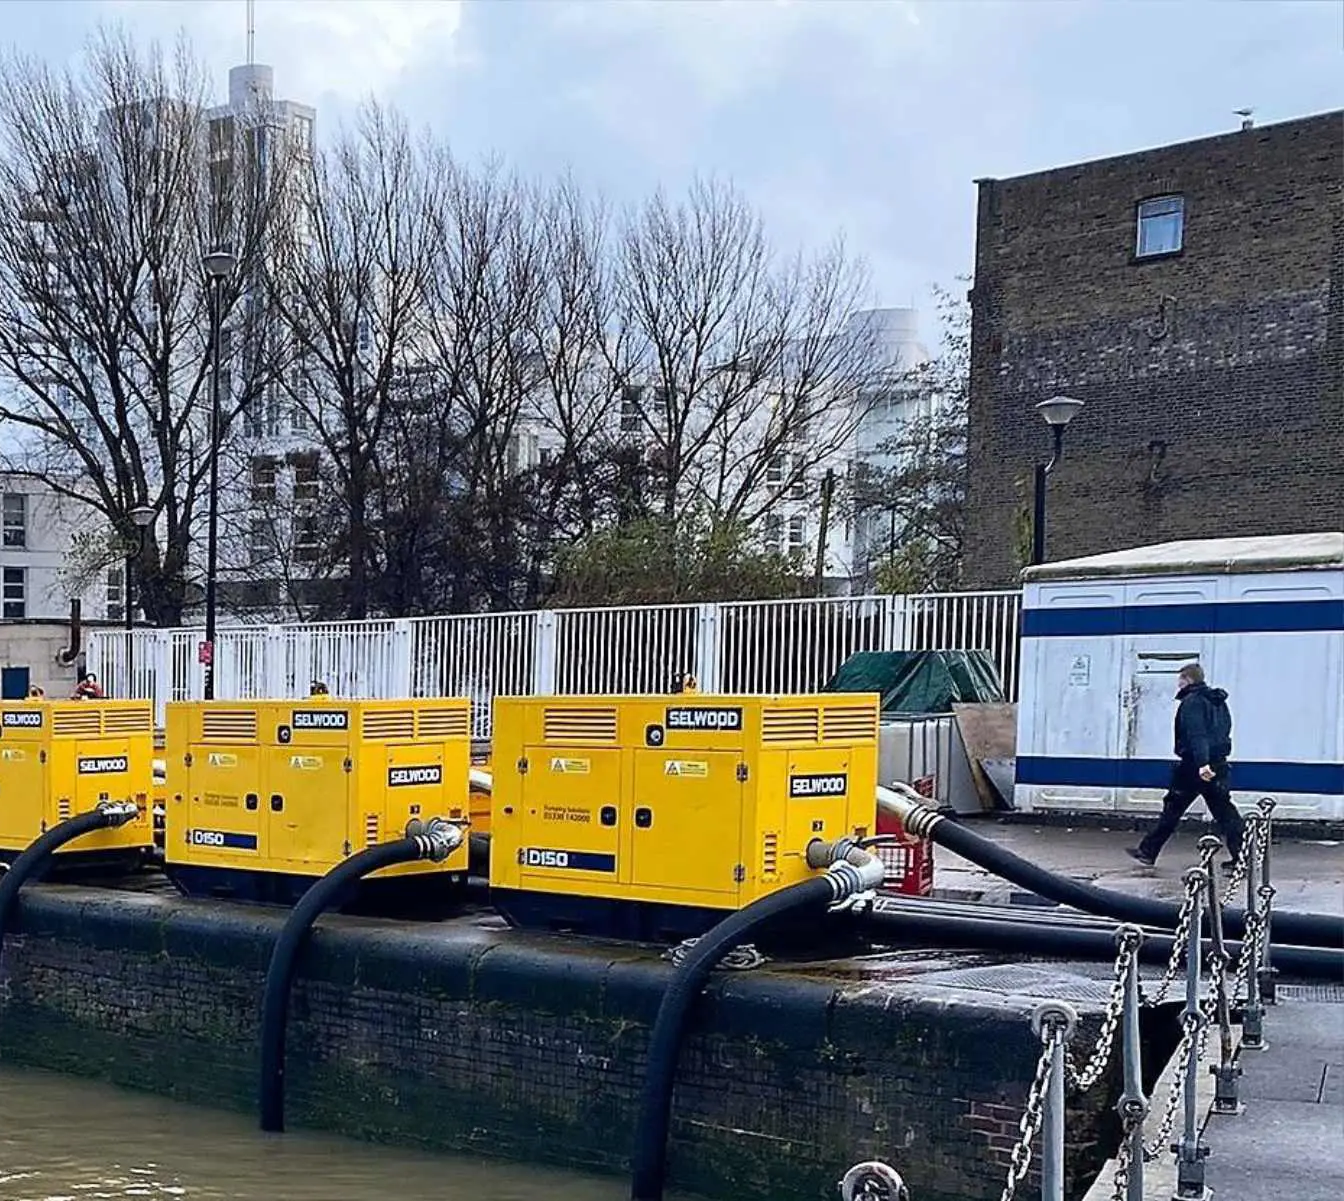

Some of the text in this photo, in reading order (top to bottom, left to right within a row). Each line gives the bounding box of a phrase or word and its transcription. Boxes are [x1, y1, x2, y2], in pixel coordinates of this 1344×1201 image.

[3, 712, 41, 726] SELWOOD
[294, 712, 345, 727] SELWOOD
[669, 710, 739, 727] SELWOOD
[79, 757, 127, 773] SELWOOD
[390, 768, 440, 785] SELWOOD
[792, 776, 845, 795] SELWOOD
[195, 830, 224, 846] D150
[528, 849, 569, 867] D150
